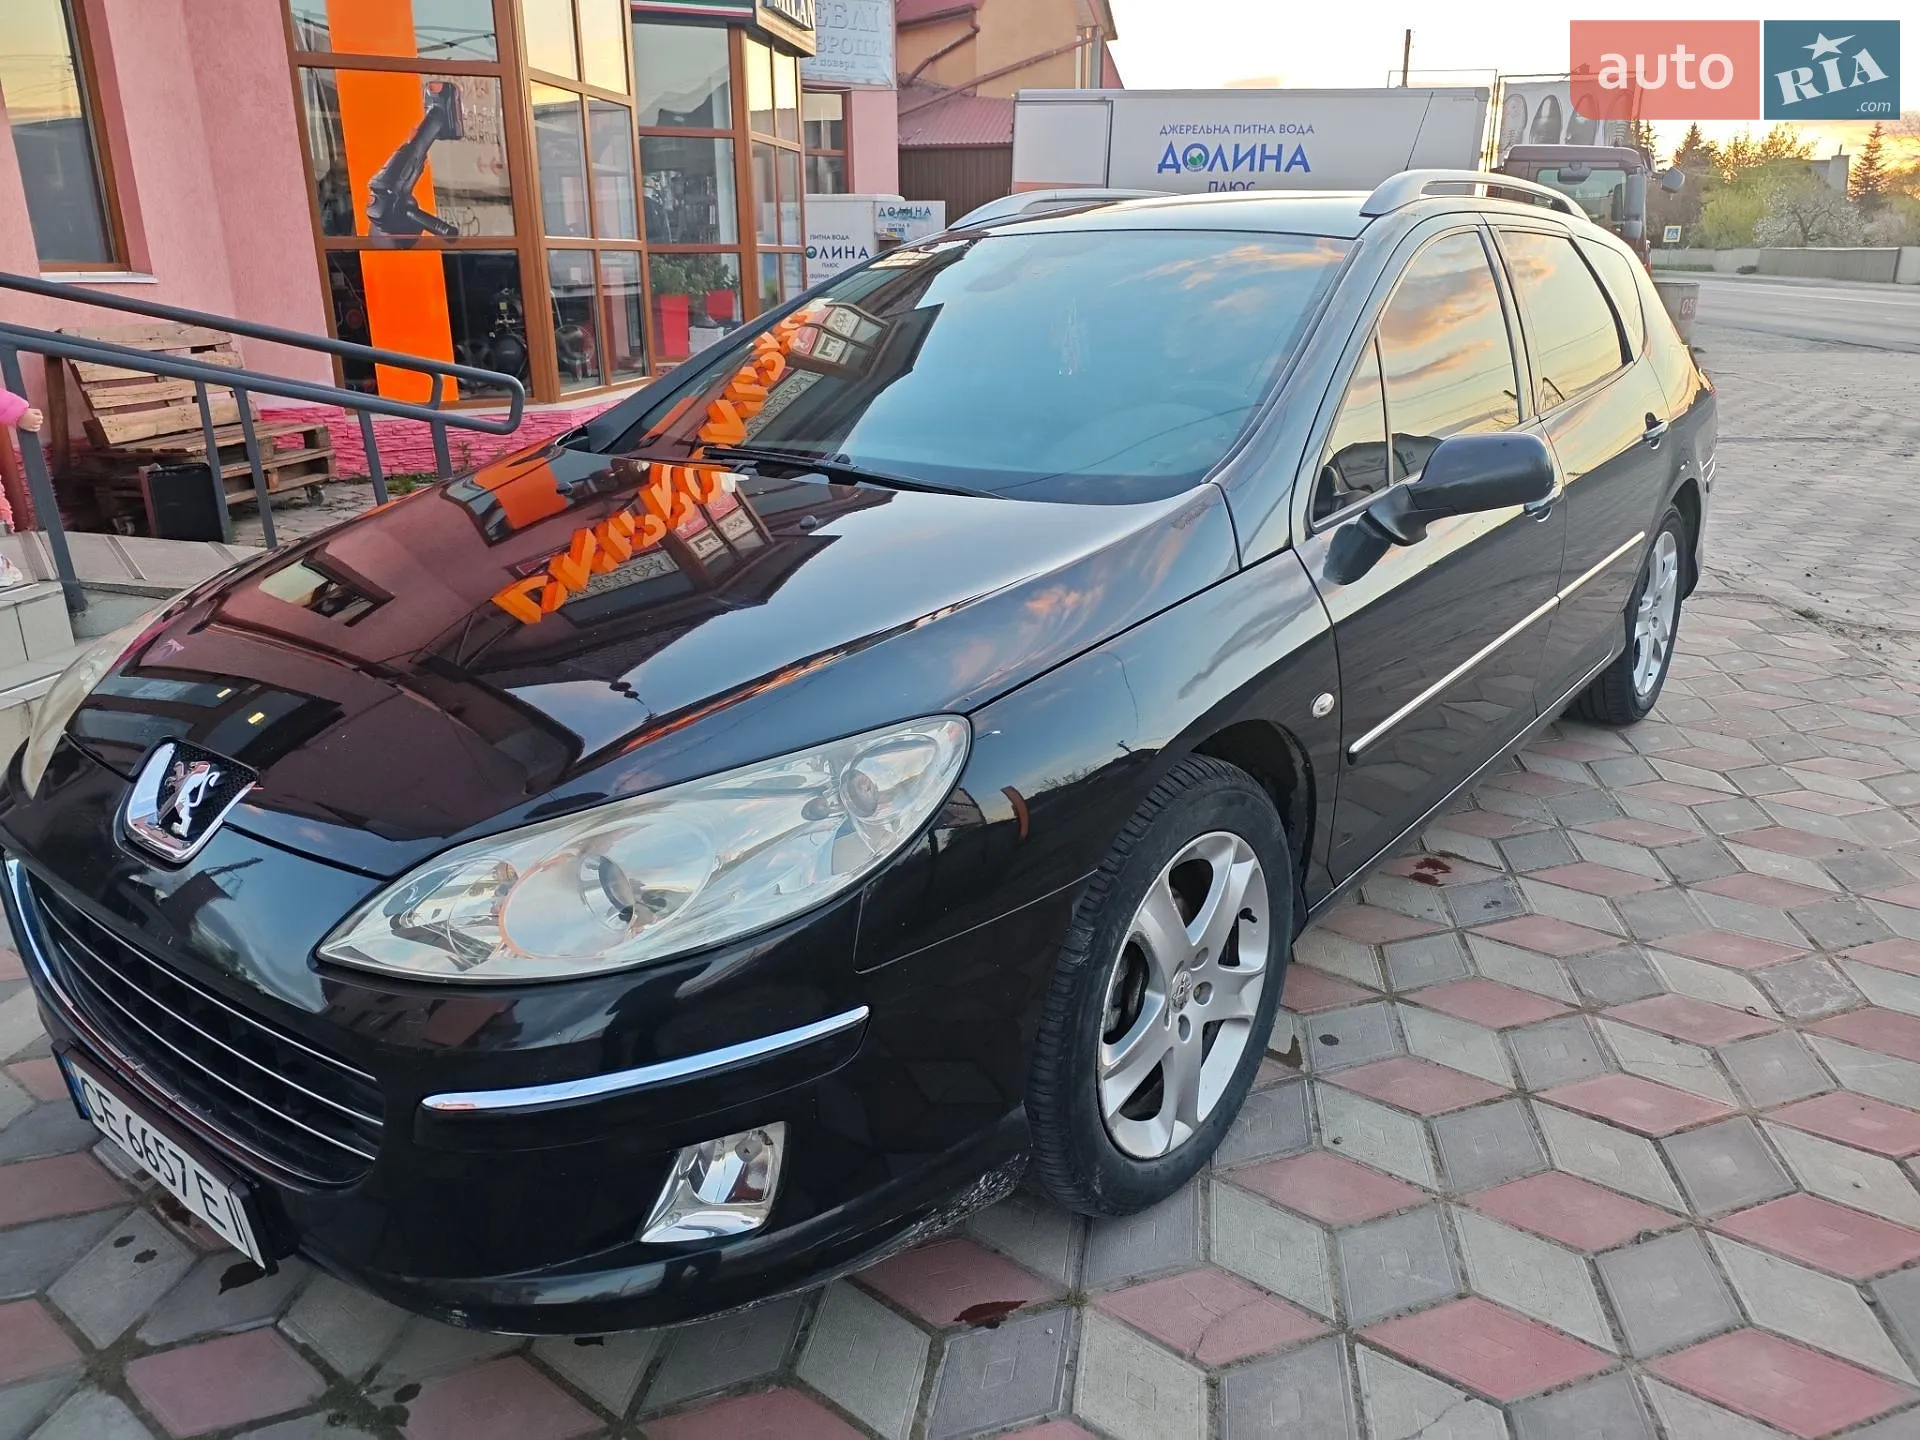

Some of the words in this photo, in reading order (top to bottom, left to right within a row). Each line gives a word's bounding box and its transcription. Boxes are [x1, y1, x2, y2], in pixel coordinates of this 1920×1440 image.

[816, 3, 880, 33] ЕБЛІ
[816, 35, 882, 57] ВРОПИ
[1160, 124, 1231, 136] ДЖЕРЕЛЬНА
[1234, 124, 1276, 135] ПИТНА
[1279, 123, 1315, 135] ВОДА
[1157, 141, 1311, 174] ДОЛИНА
[805, 246, 869, 260] ОЛИНА
[80, 1076, 124, 1143] CE
[126, 1114, 188, 1197] 6657
